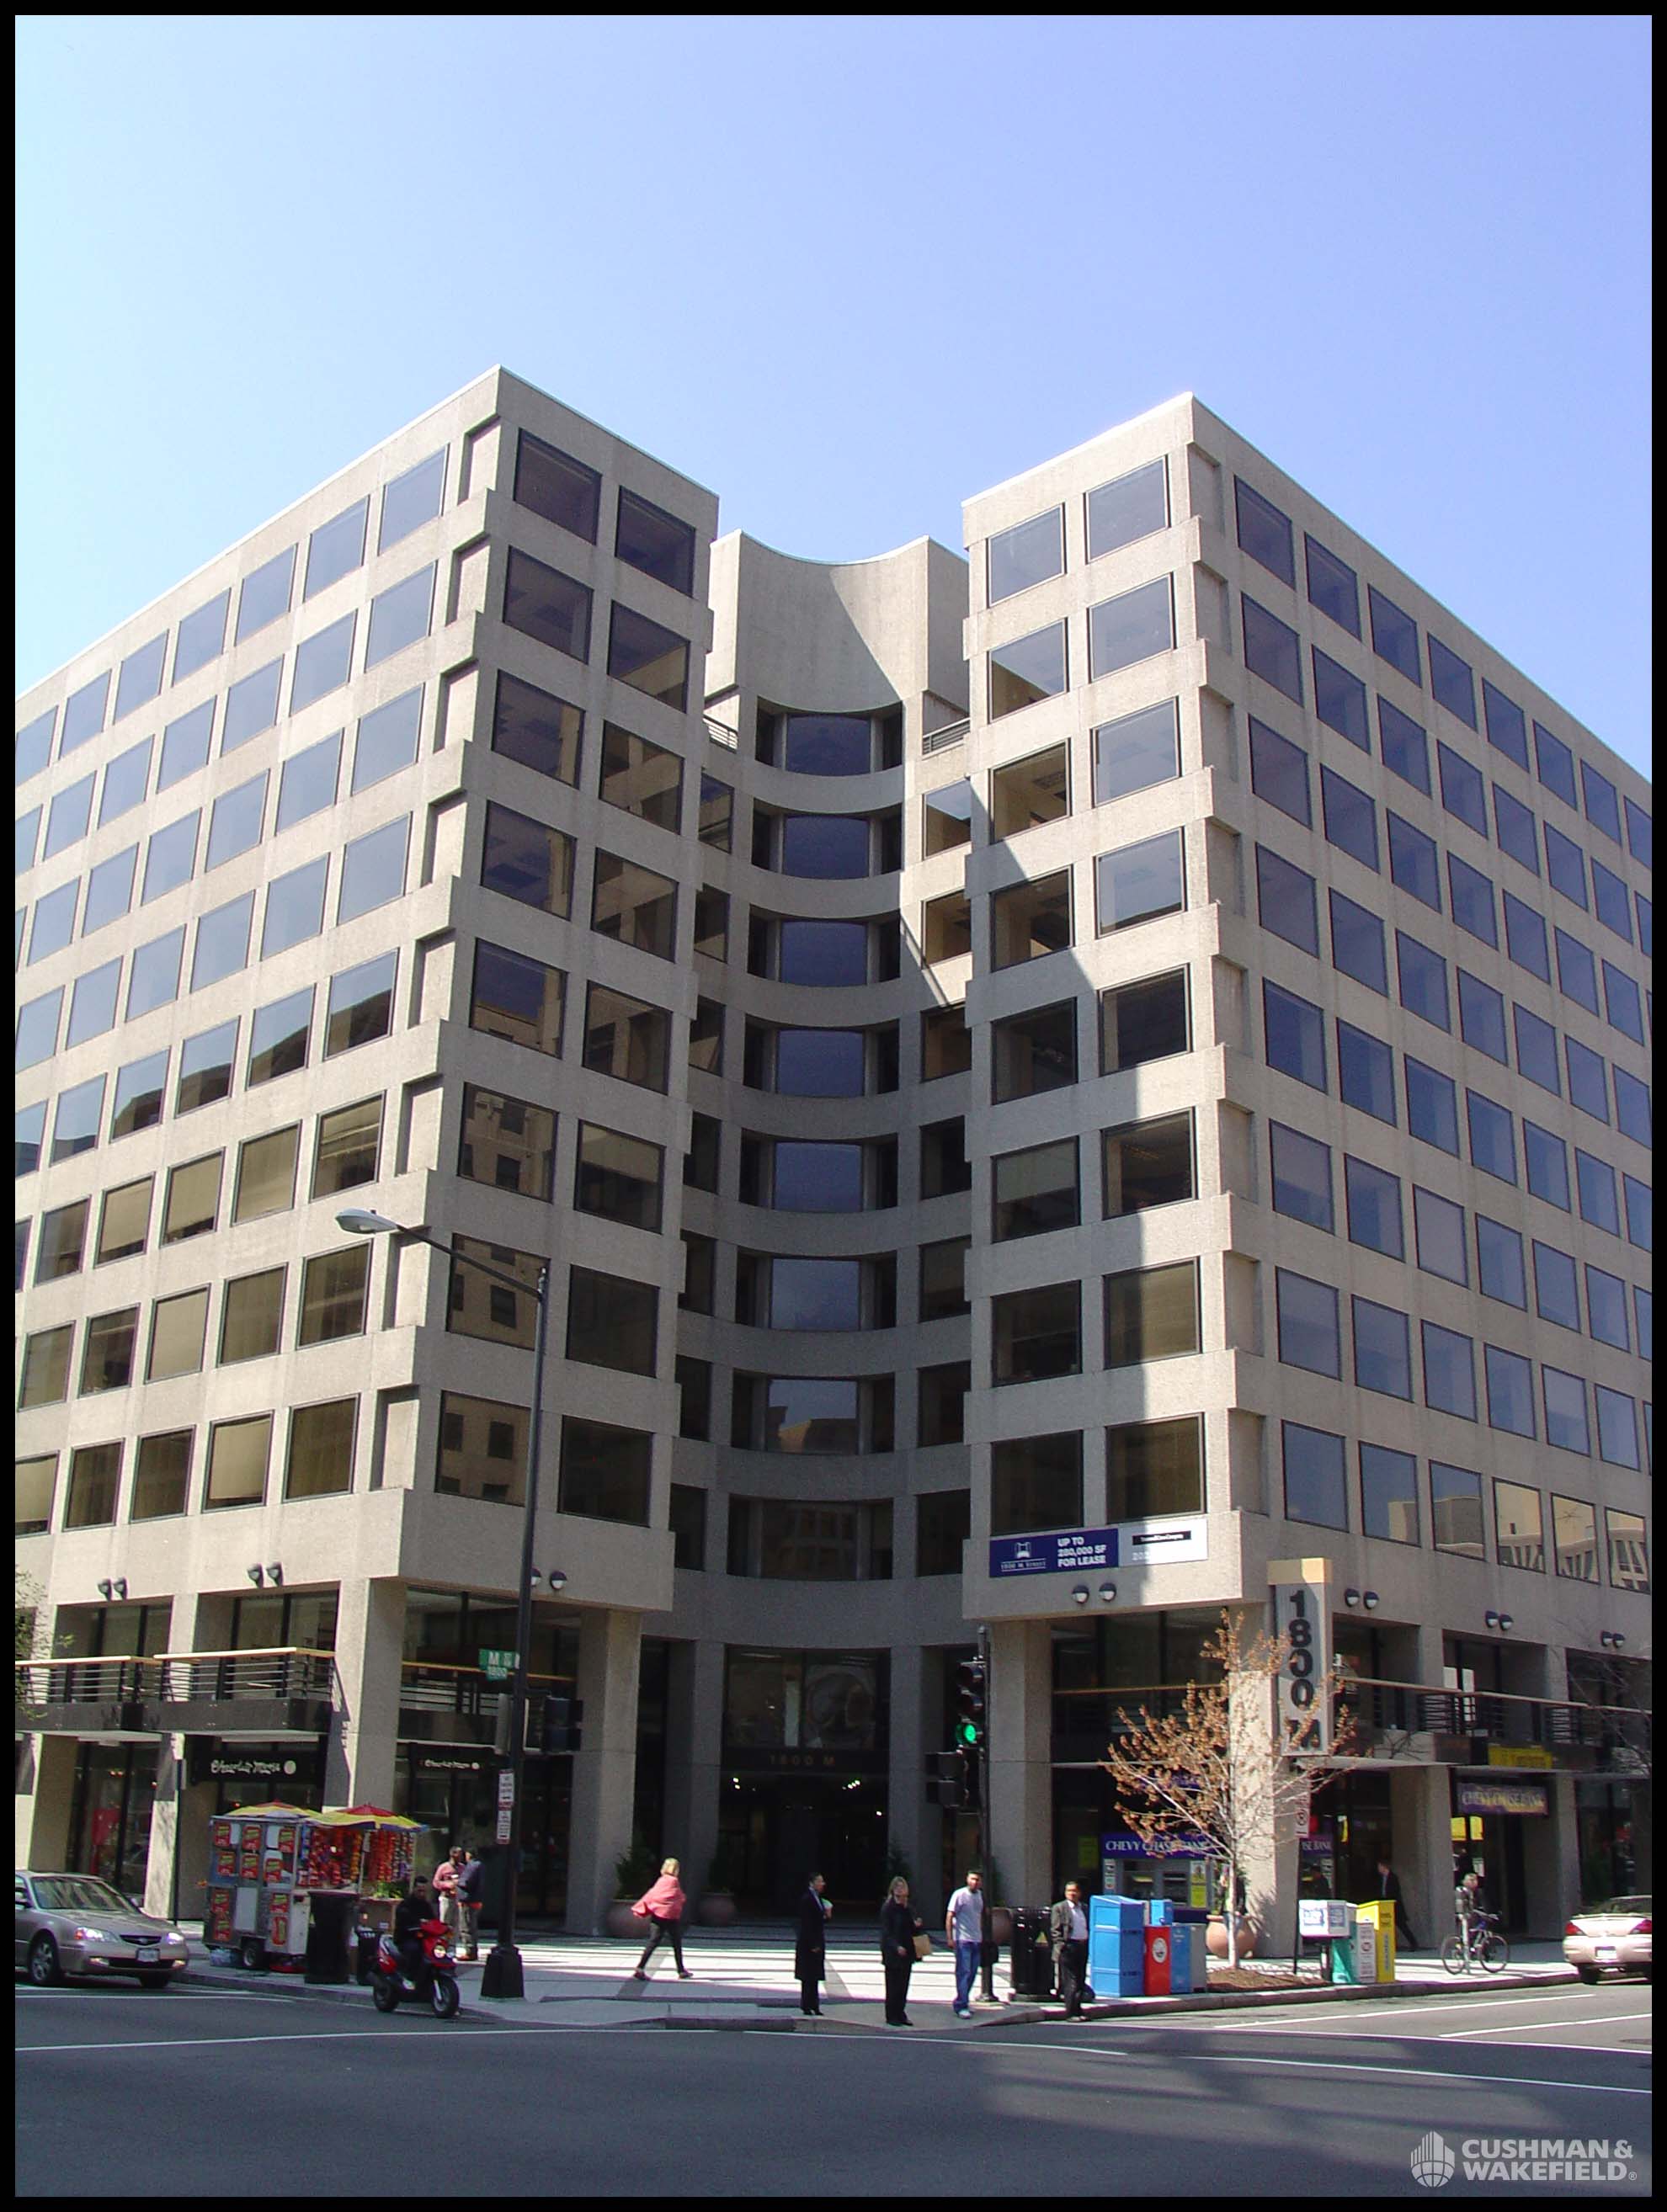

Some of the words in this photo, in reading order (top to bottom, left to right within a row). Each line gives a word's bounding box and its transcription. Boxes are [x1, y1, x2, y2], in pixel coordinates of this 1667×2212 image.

[1057, 1538, 1071, 1547] UP
[1072, 1536, 1085, 1546] TO
[1094, 1544, 1107, 1555] SF
[1057, 1557, 1077, 1567] FOR
[1078, 1555, 1106, 1566] LEASE
[1289, 1590, 1314, 1711] 1800
[1105, 1841, 1141, 1851] CHEVY
